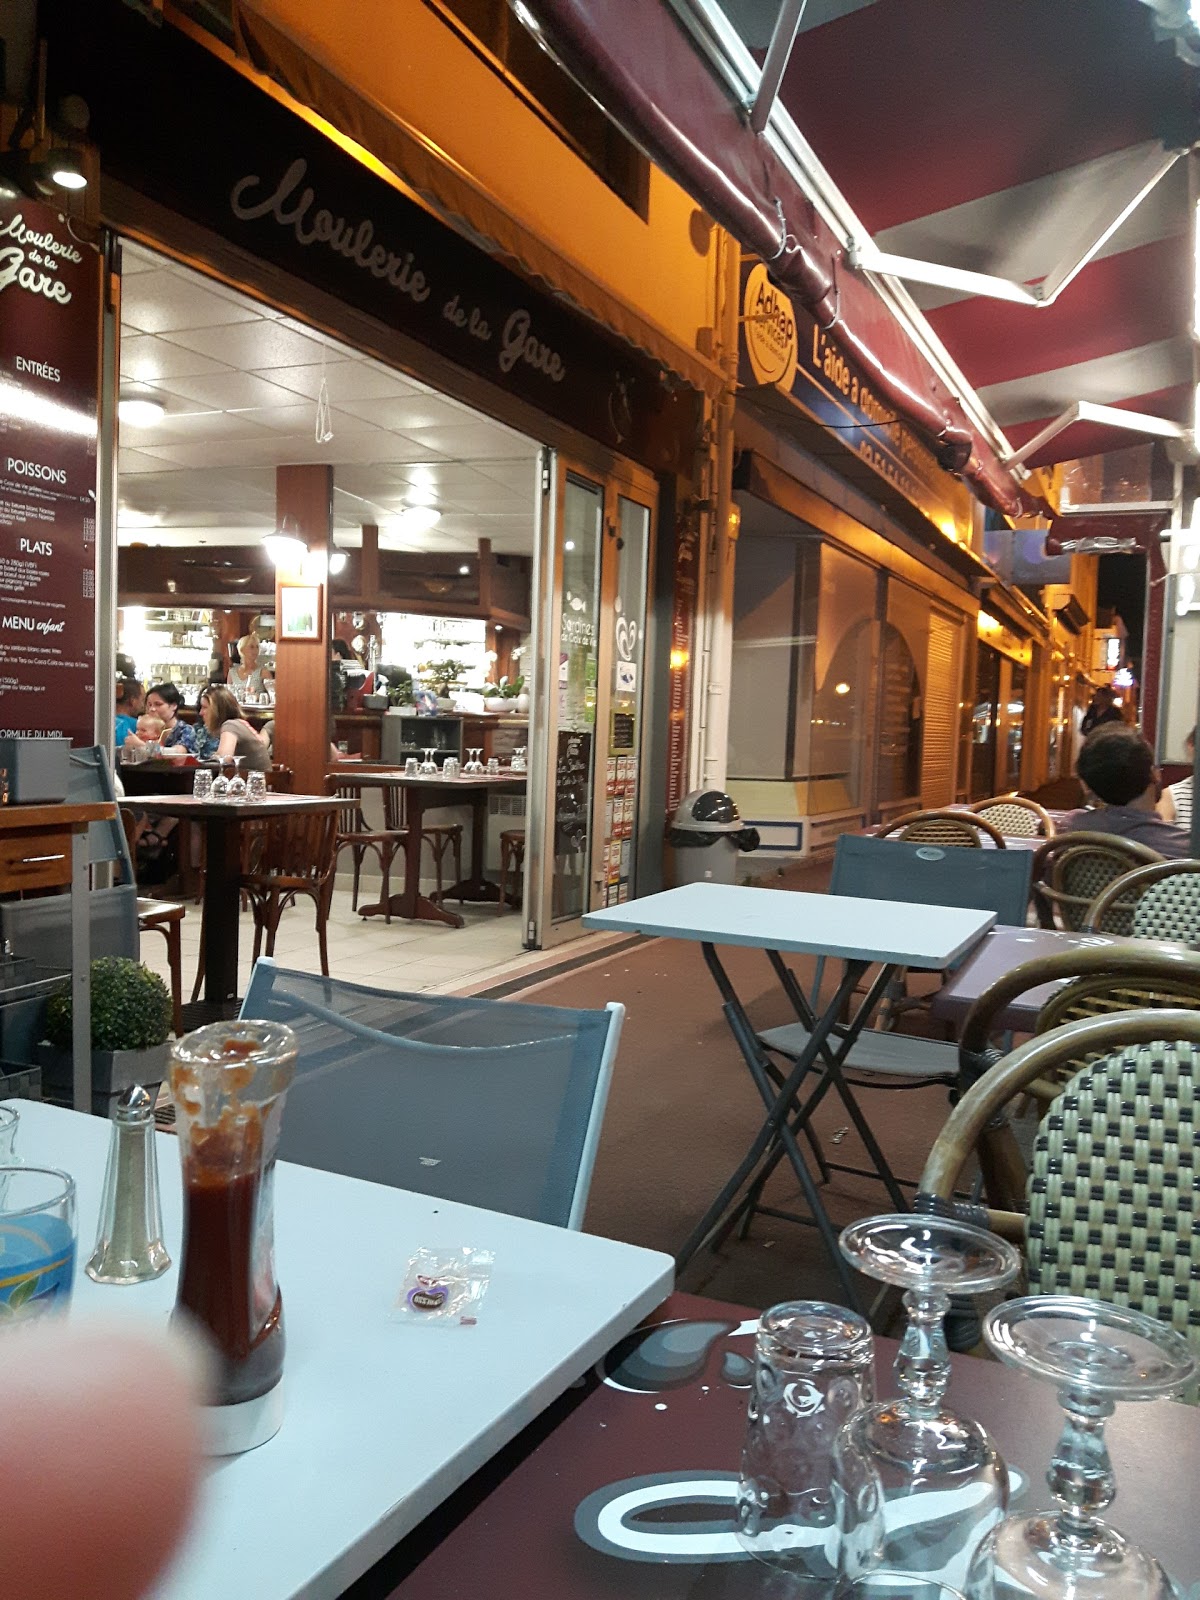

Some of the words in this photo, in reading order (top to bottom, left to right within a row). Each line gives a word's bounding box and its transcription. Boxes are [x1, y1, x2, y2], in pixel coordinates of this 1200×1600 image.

[0, 214, 83, 264] Moulerie
[28, 249, 43, 264] de
[44, 255, 58, 270] la
[230, 158, 430, 303] Moulerie
[441, 294, 468, 328] de
[469, 306, 491, 341] la
[500, 309, 566, 382] Gare
[0, 246, 72, 305] Gare
[755, 282, 794, 342] Adhap
[16, 356, 61, 383] ENTRÉES
[812, 323, 850, 396] L'aide
[7, 457, 67, 485] POISSONS
[20, 538, 53, 556] PLATS
[2, 616, 35, 631] MENU
[36, 618, 66, 635] enfant
[0, 729, 32, 739] ORMULE
[34, 730, 45, 739] DU
[47, 730, 63, 739] MIDI
